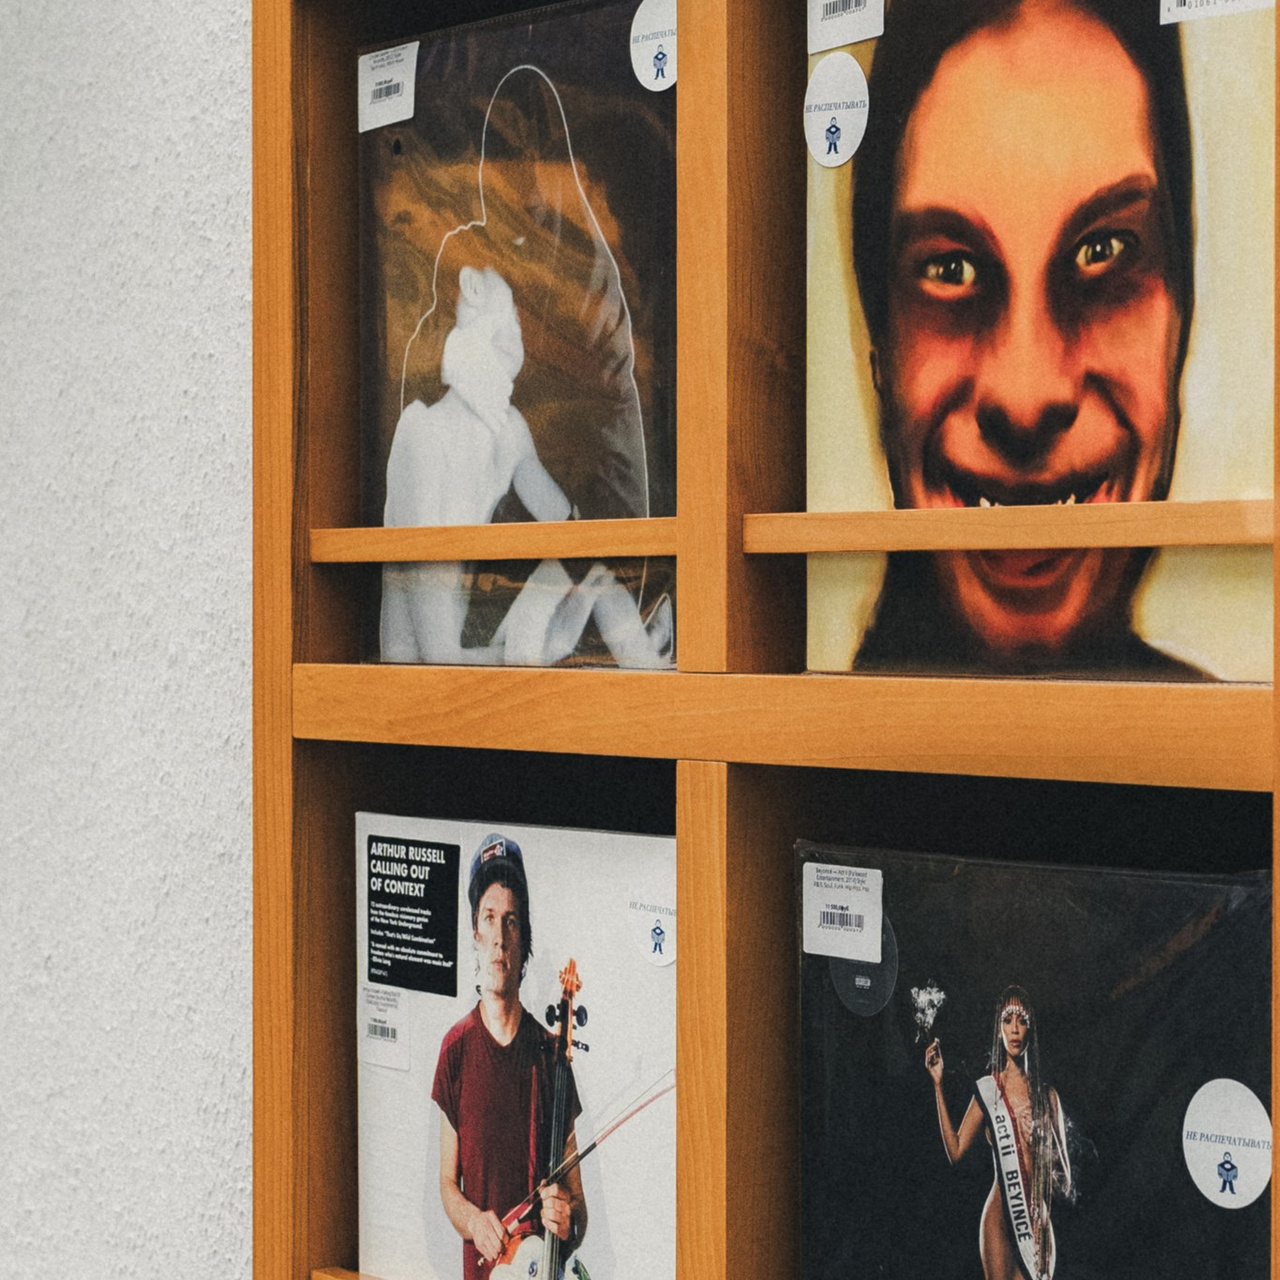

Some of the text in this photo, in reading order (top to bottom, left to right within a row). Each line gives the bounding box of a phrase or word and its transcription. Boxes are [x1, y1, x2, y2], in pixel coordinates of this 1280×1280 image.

[370, 842, 446, 864] ARTHUR RUSSELL
[370, 859, 430, 880] CALLING OUT
[370, 877, 425, 897] OF CONTEXT
[995, 1114, 1015, 1157] act ii
[1186, 1130, 1272, 1150] НЕ РАСПЕЧАТЫВАТЬ
